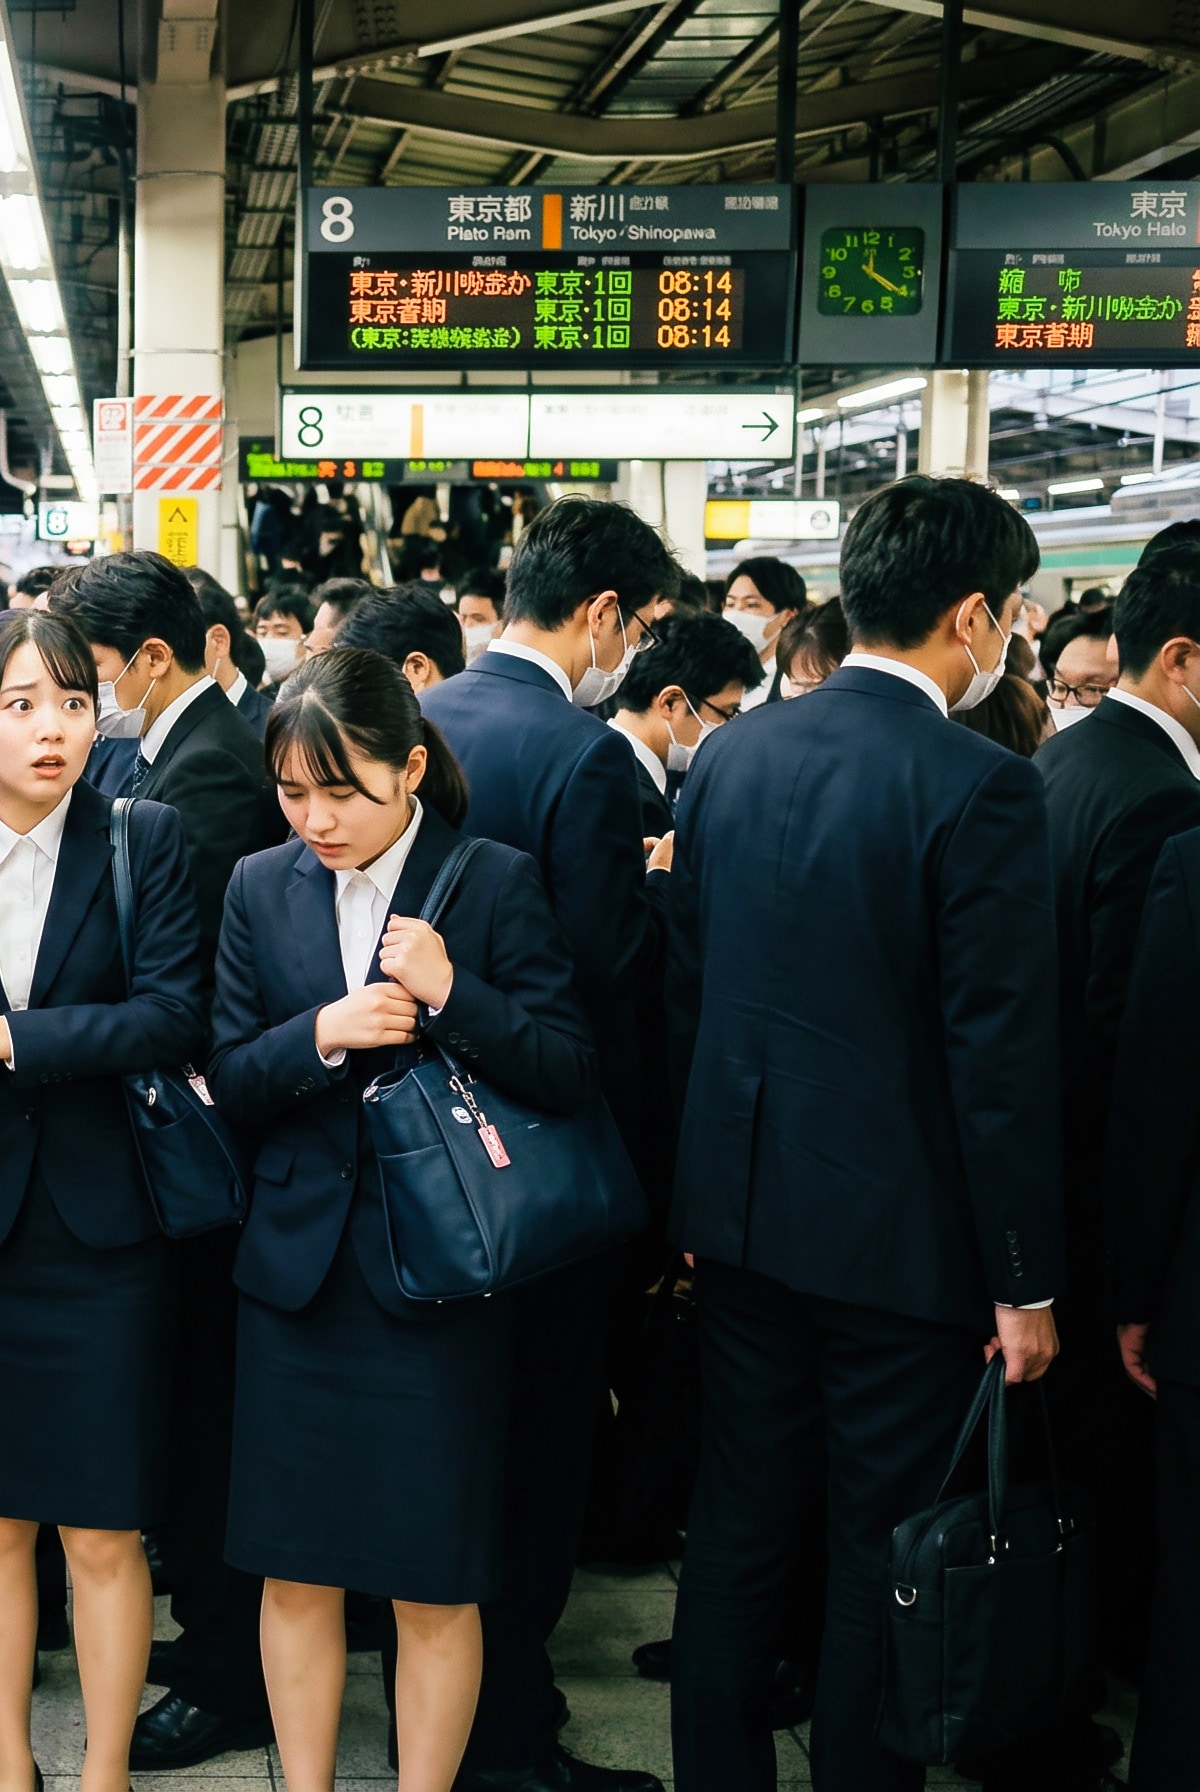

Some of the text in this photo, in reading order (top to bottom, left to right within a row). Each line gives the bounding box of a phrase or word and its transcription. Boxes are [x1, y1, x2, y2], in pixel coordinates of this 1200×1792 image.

[447, 195, 532, 223] 東京都
[570, 194, 625, 222] 新川
[1130, 190, 1188, 219] 東京
[320, 196, 355, 243] 8
[1092, 222, 1187, 240] Tokyo Halo
[570, 226, 617, 244] Tokyo
[863, 231, 880, 245] 12
[829, 247, 848, 261] 10
[898, 247, 912, 261] 2
[658, 271, 733, 295] 08:14
[657, 298, 732, 322] 08:14
[843, 296, 857, 313] 7
[861, 299, 875, 314] 6
[656, 325, 731, 349] 08:14
[298, 406, 324, 448] 8
